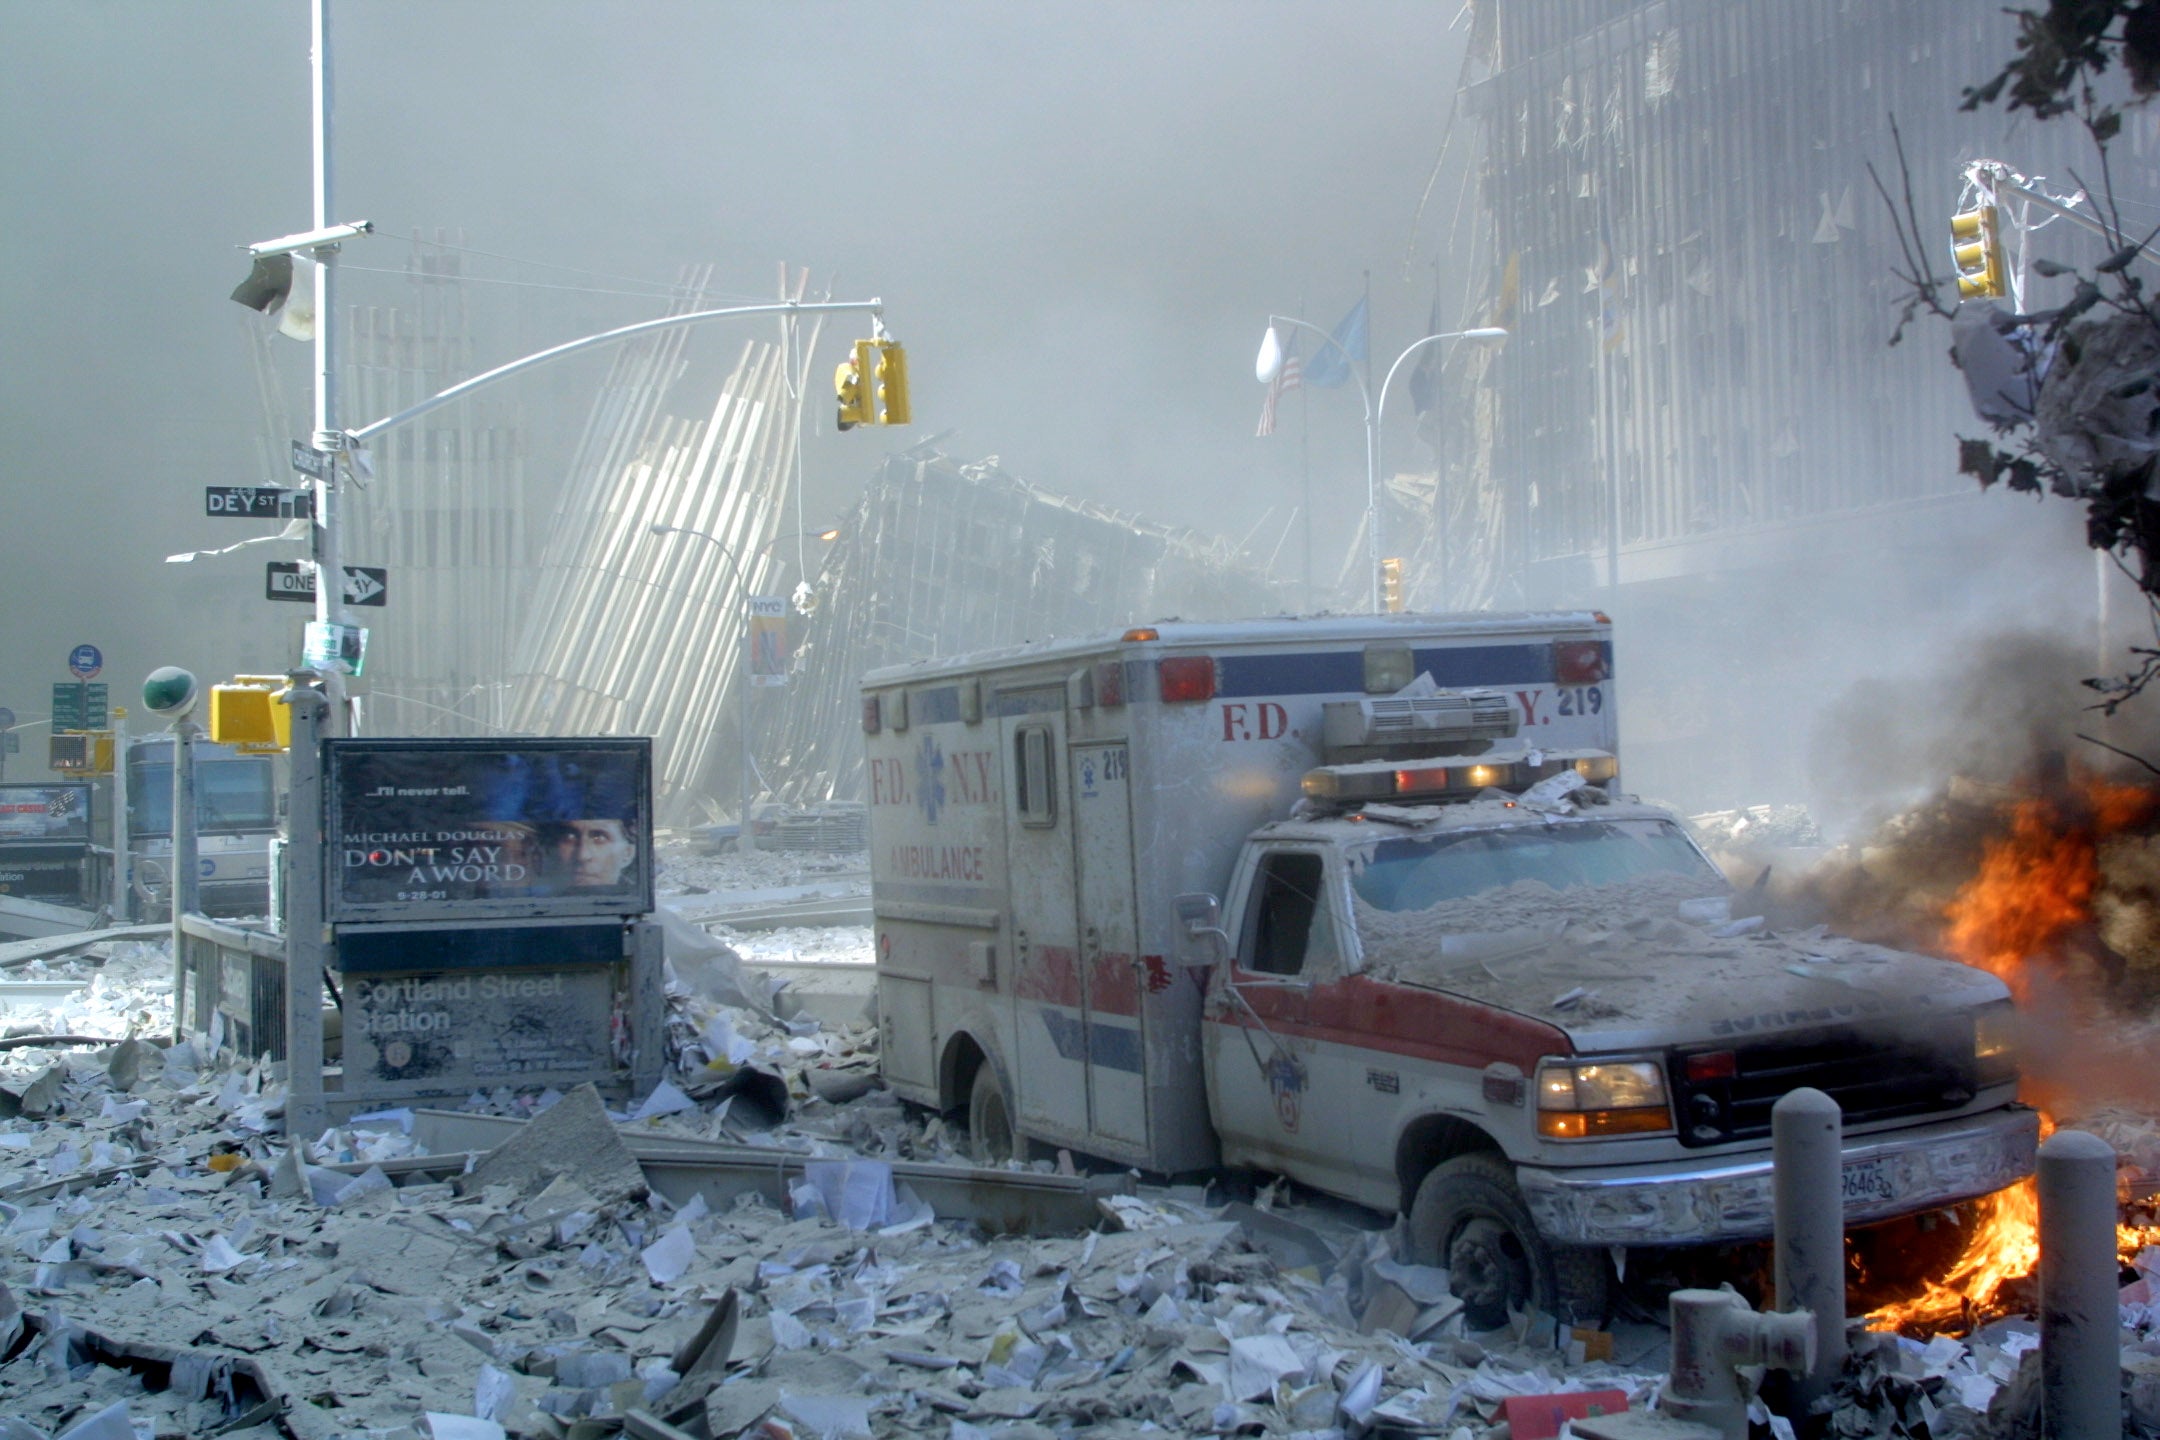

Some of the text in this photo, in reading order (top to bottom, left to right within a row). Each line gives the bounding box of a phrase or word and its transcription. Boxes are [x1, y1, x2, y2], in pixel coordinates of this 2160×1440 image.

[209, 494, 276, 512] DEY ST
[283, 575, 315, 591] ONE
[753, 602, 782, 613] NYC
[1557, 687, 1602, 716] 219
[1222, 702, 1299, 742] F.D.
[872, 752, 998, 805] F.D. N.Y.
[397, 788, 439, 796] never
[343, 831, 525, 844] MICHAEL DOUGLAS
[345, 846, 502, 868] DON'T SAY
[891, 846, 984, 881] AMBULANCE
[407, 864, 526, 885] A WORD
[355, 972, 563, 1002] Cortland Street
[355, 1007, 449, 1033] Station
